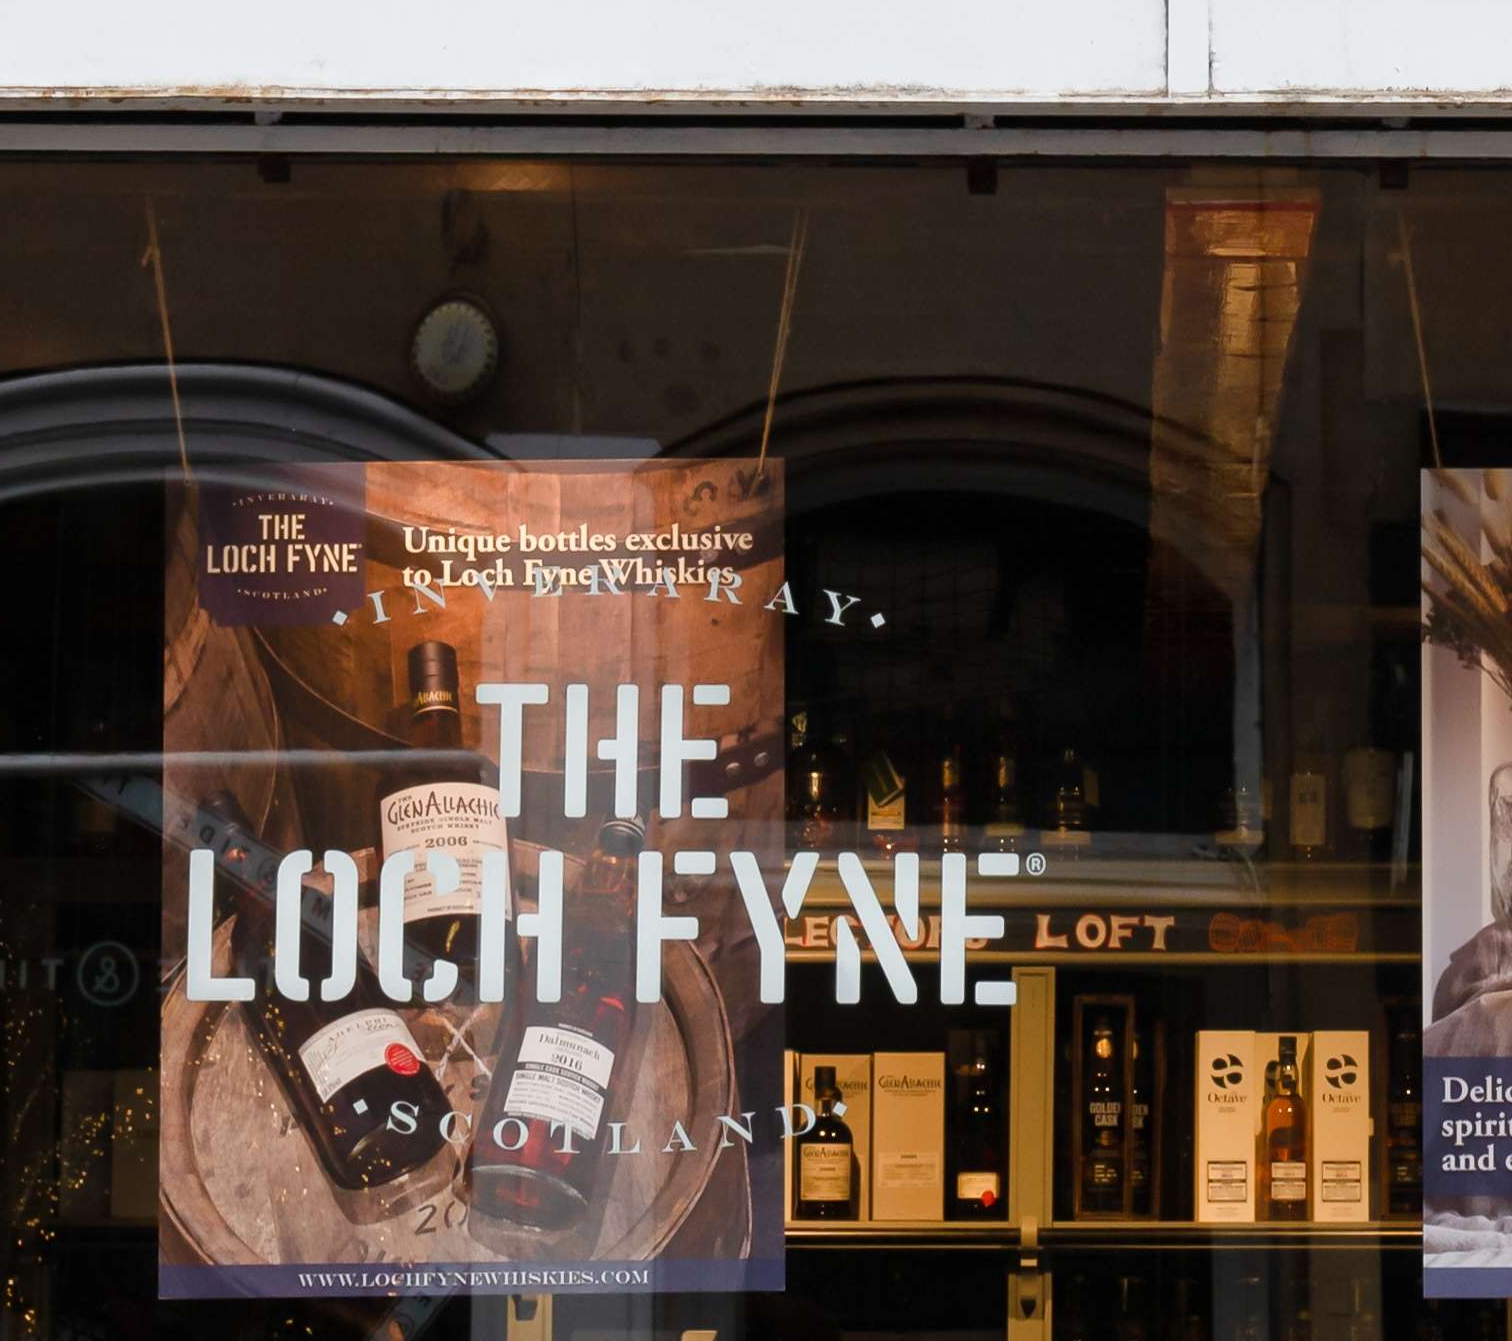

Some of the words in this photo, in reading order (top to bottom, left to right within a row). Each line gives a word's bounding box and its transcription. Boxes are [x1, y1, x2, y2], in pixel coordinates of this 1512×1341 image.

[238, 493, 328, 506] INVERARAY
[258, 514, 306, 540] THE
[402, 526, 511, 558] Unique
[519, 524, 617, 553] bottles
[624, 523, 754, 553] exclusive
[207, 545, 276, 573] LOCH
[402, 562, 430, 587] to
[441, 559, 516, 587] Loch
[522, 560, 593, 594] Fyne
[593, 557, 736, 586] Whiskies
[244, 588, 323, 600] SCOTLAND
[370, 562, 862, 628] INVERARAY
[476, 683, 731, 819] THE
[425, 836, 467, 848] 2006
[186, 849, 565, 1004] LOCH
[1034, 913, 1176, 950] LOFT
[552, 1053, 584, 1071] 2016
[386, 1100, 816, 1155] SCOTLAND
[1441, 1144, 1496, 1171] and
[298, 1269, 649, 1288] WWW.LOCHFYNEWHISKIES.COM
